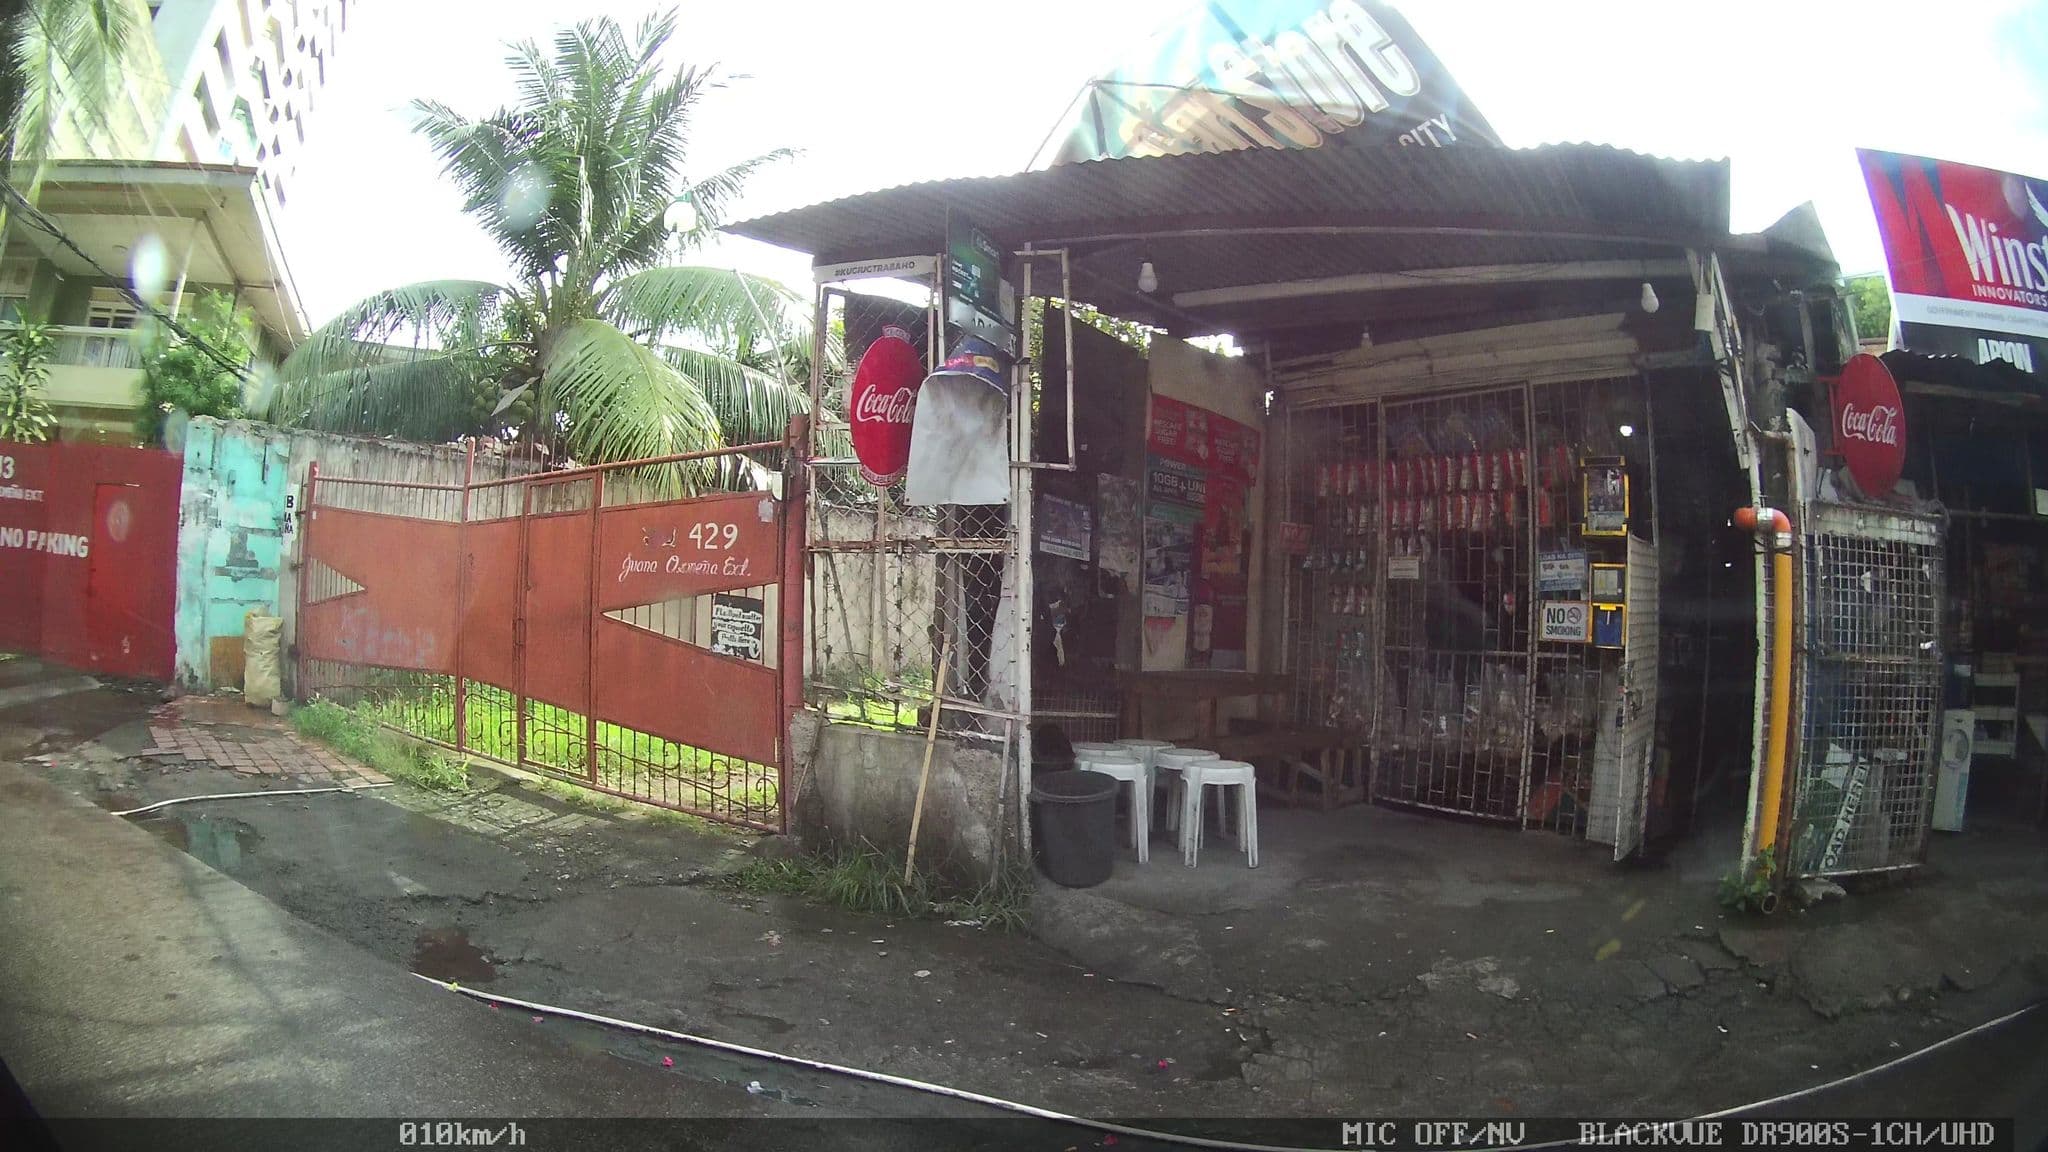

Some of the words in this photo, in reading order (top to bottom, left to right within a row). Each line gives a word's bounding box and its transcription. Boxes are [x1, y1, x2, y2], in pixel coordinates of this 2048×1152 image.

[1972, 284, 2048, 308] INNOVATORS
[1842, 403, 1897, 447] Coca-Cola
[1153, 471, 1178, 488] 10GB
[0, 526, 24, 548] NO
[689, 522, 738, 550] 429
[618, 552, 658, 583] Juana
[665, 555, 718, 576] Osmeña
[1546, 607, 1566, 624] NO
[1545, 625, 1581, 637] SMOKING
